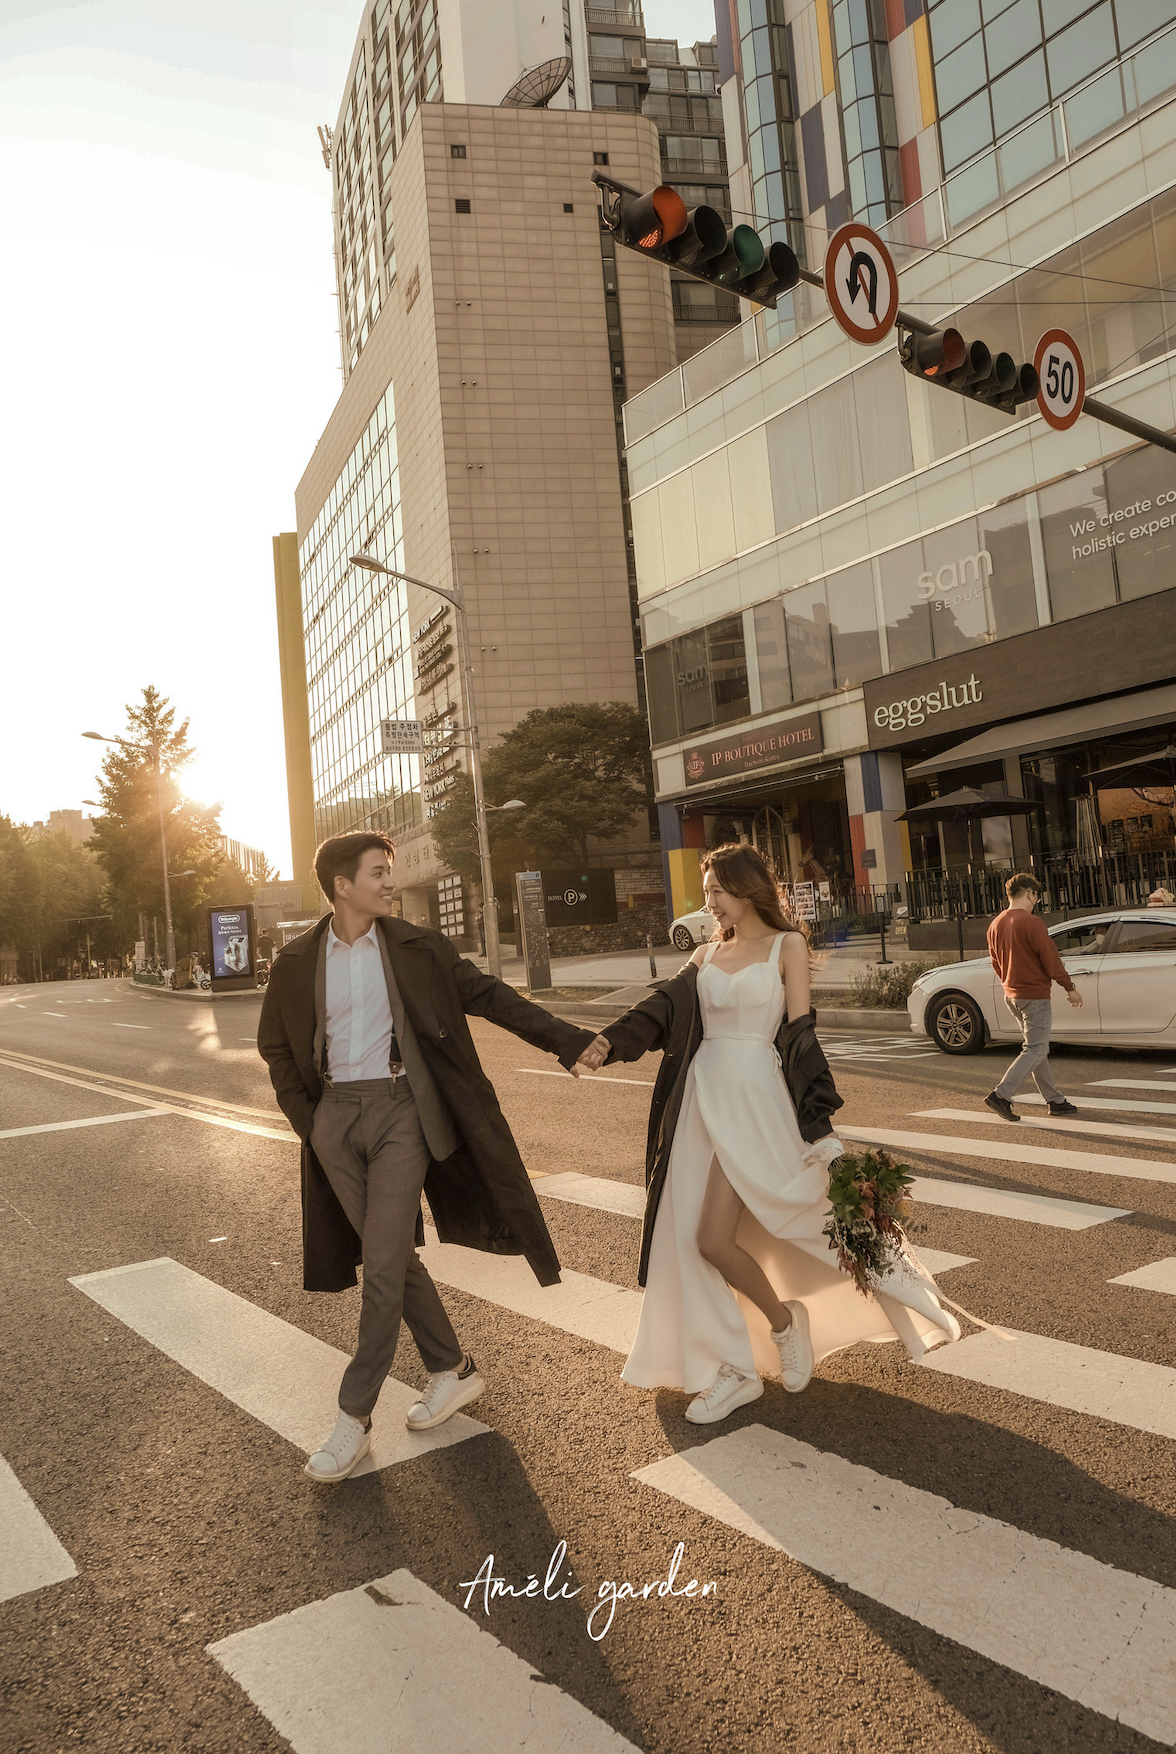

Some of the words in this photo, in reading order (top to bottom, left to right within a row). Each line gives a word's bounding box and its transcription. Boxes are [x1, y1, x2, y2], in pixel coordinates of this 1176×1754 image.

[1046, 354, 1074, 404] 50
[1069, 519, 1096, 538] We
[1099, 500, 1152, 527] create
[1156, 490, 1176, 506] co
[1072, 531, 1126, 560] holistic
[1129, 513, 1176, 539] exper
[917, 550, 994, 599] sam
[935, 588, 981, 612] SEOUL
[677, 664, 708, 686] sam
[874, 673, 983, 731] eggslut
[711, 752, 722, 766] IP
[724, 738, 777, 762] BOUTIQUE
[778, 728, 815, 748] HOTEL
[895, 926, 907, 935] OPEN
